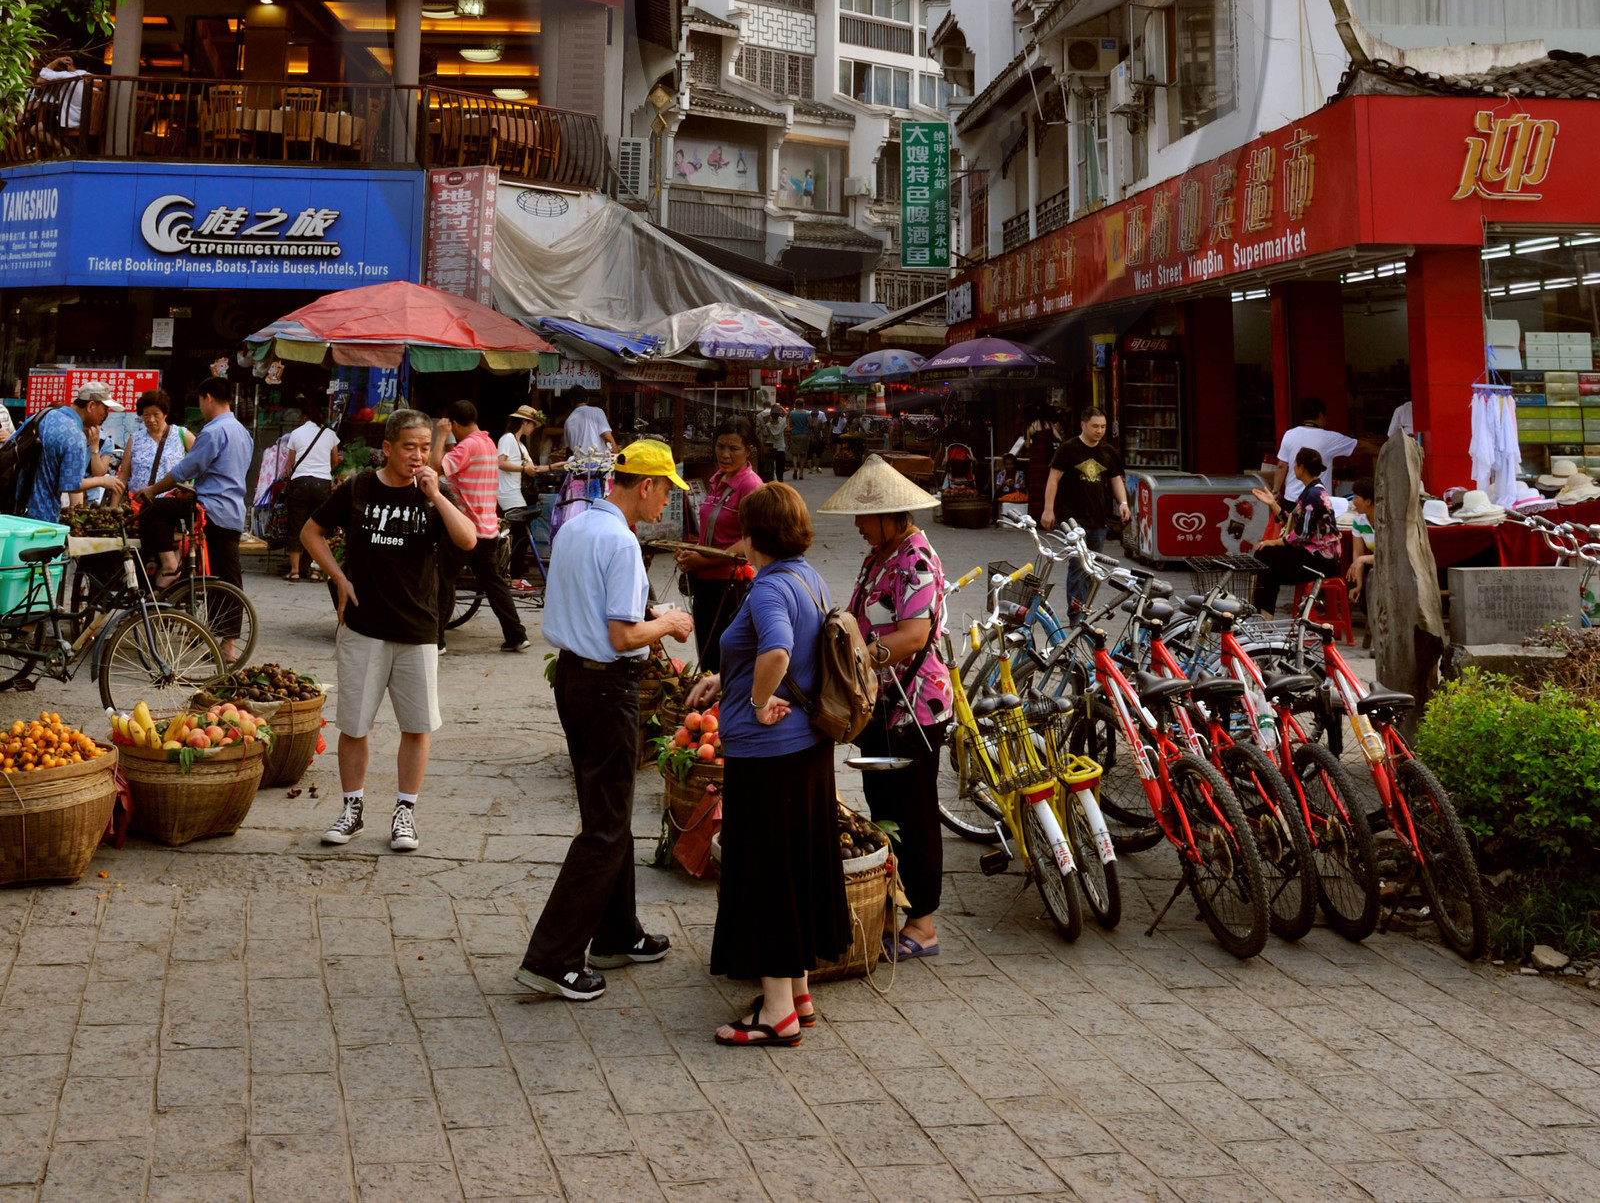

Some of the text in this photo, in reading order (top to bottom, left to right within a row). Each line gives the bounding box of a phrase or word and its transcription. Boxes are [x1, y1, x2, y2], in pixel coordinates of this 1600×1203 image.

[933, 130, 947, 190] 绝味小龙虾
[1451, 110, 1559, 201] 迎
[2, 187, 58, 222] YANGSHUO
[906, 125, 930, 265] 大嫂特色啤酒鱼
[198, 205, 341, 238] 桂之旅
[88, 257, 122, 272] Ticket
[1134, 226, 1307, 291] West Street YingBin Supermarket
[782, 349, 804, 359] PEPSI
[371, 532, 404, 546] Muses
